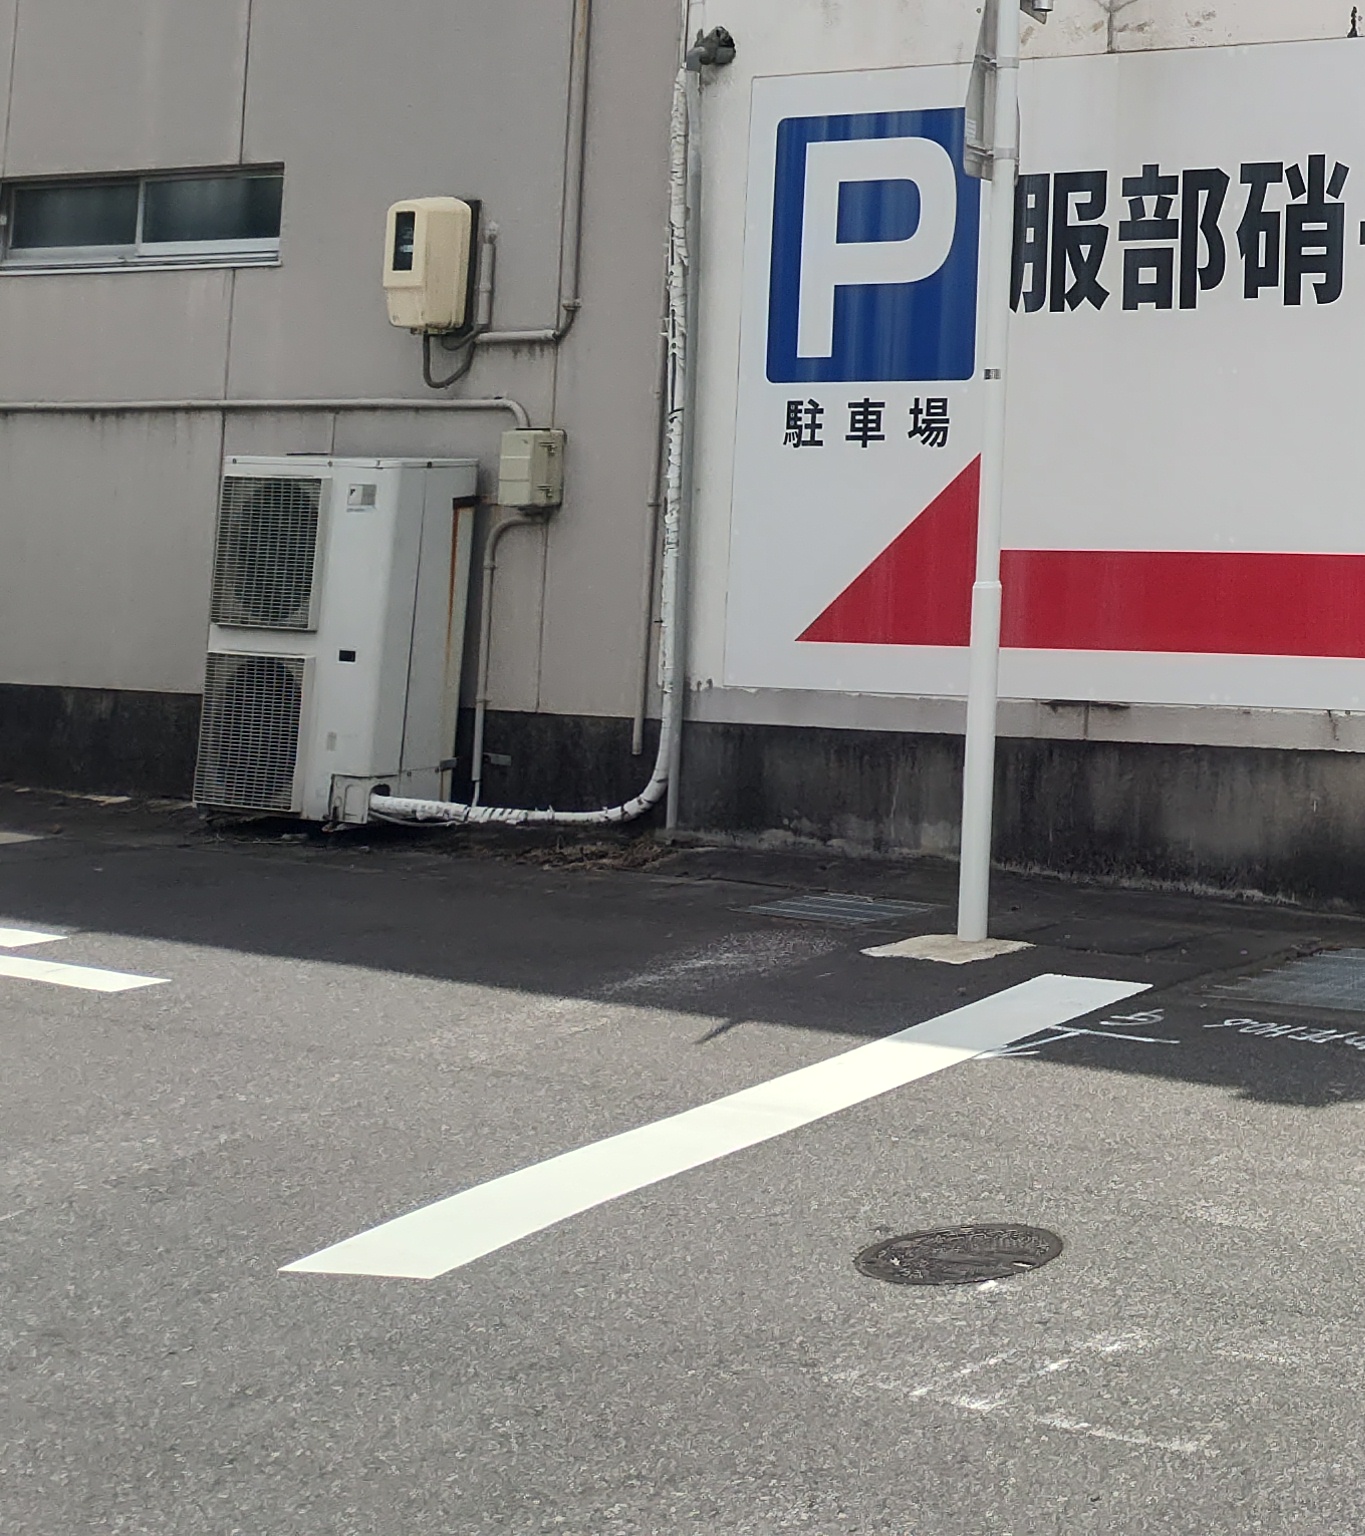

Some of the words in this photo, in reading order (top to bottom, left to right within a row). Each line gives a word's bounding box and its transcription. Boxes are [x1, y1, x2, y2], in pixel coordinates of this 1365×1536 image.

[797, 136, 955, 359] P
[782, 397, 951, 449] 駐車場
